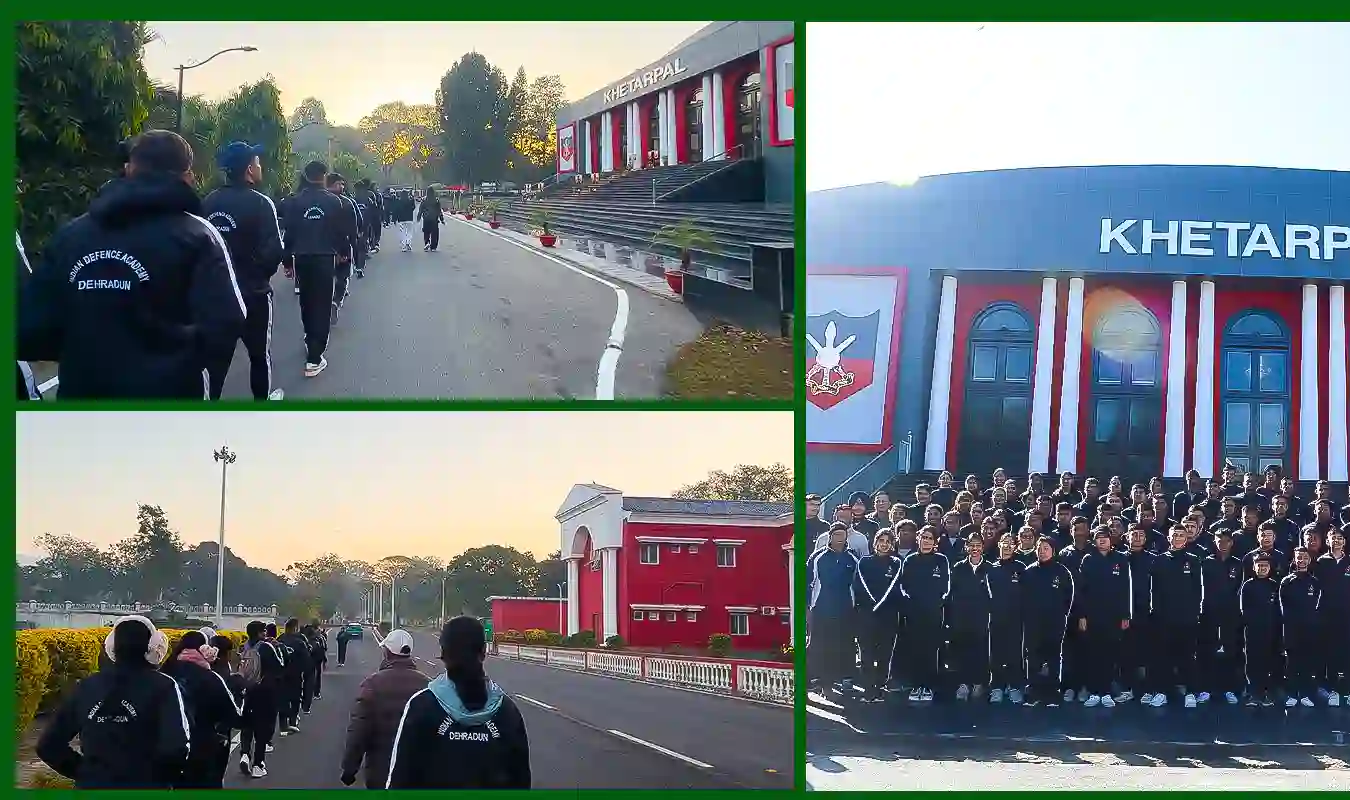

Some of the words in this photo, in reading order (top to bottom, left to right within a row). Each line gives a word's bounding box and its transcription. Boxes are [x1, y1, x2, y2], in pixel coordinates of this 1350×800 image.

[603, 58, 689, 105] KHETARPAL
[83, 249, 122, 265] DEFENCE
[120, 252, 150, 282] ACADEMY
[78, 280, 131, 291] DEHRADUN
[449, 731, 489, 742] DEHRADUN
